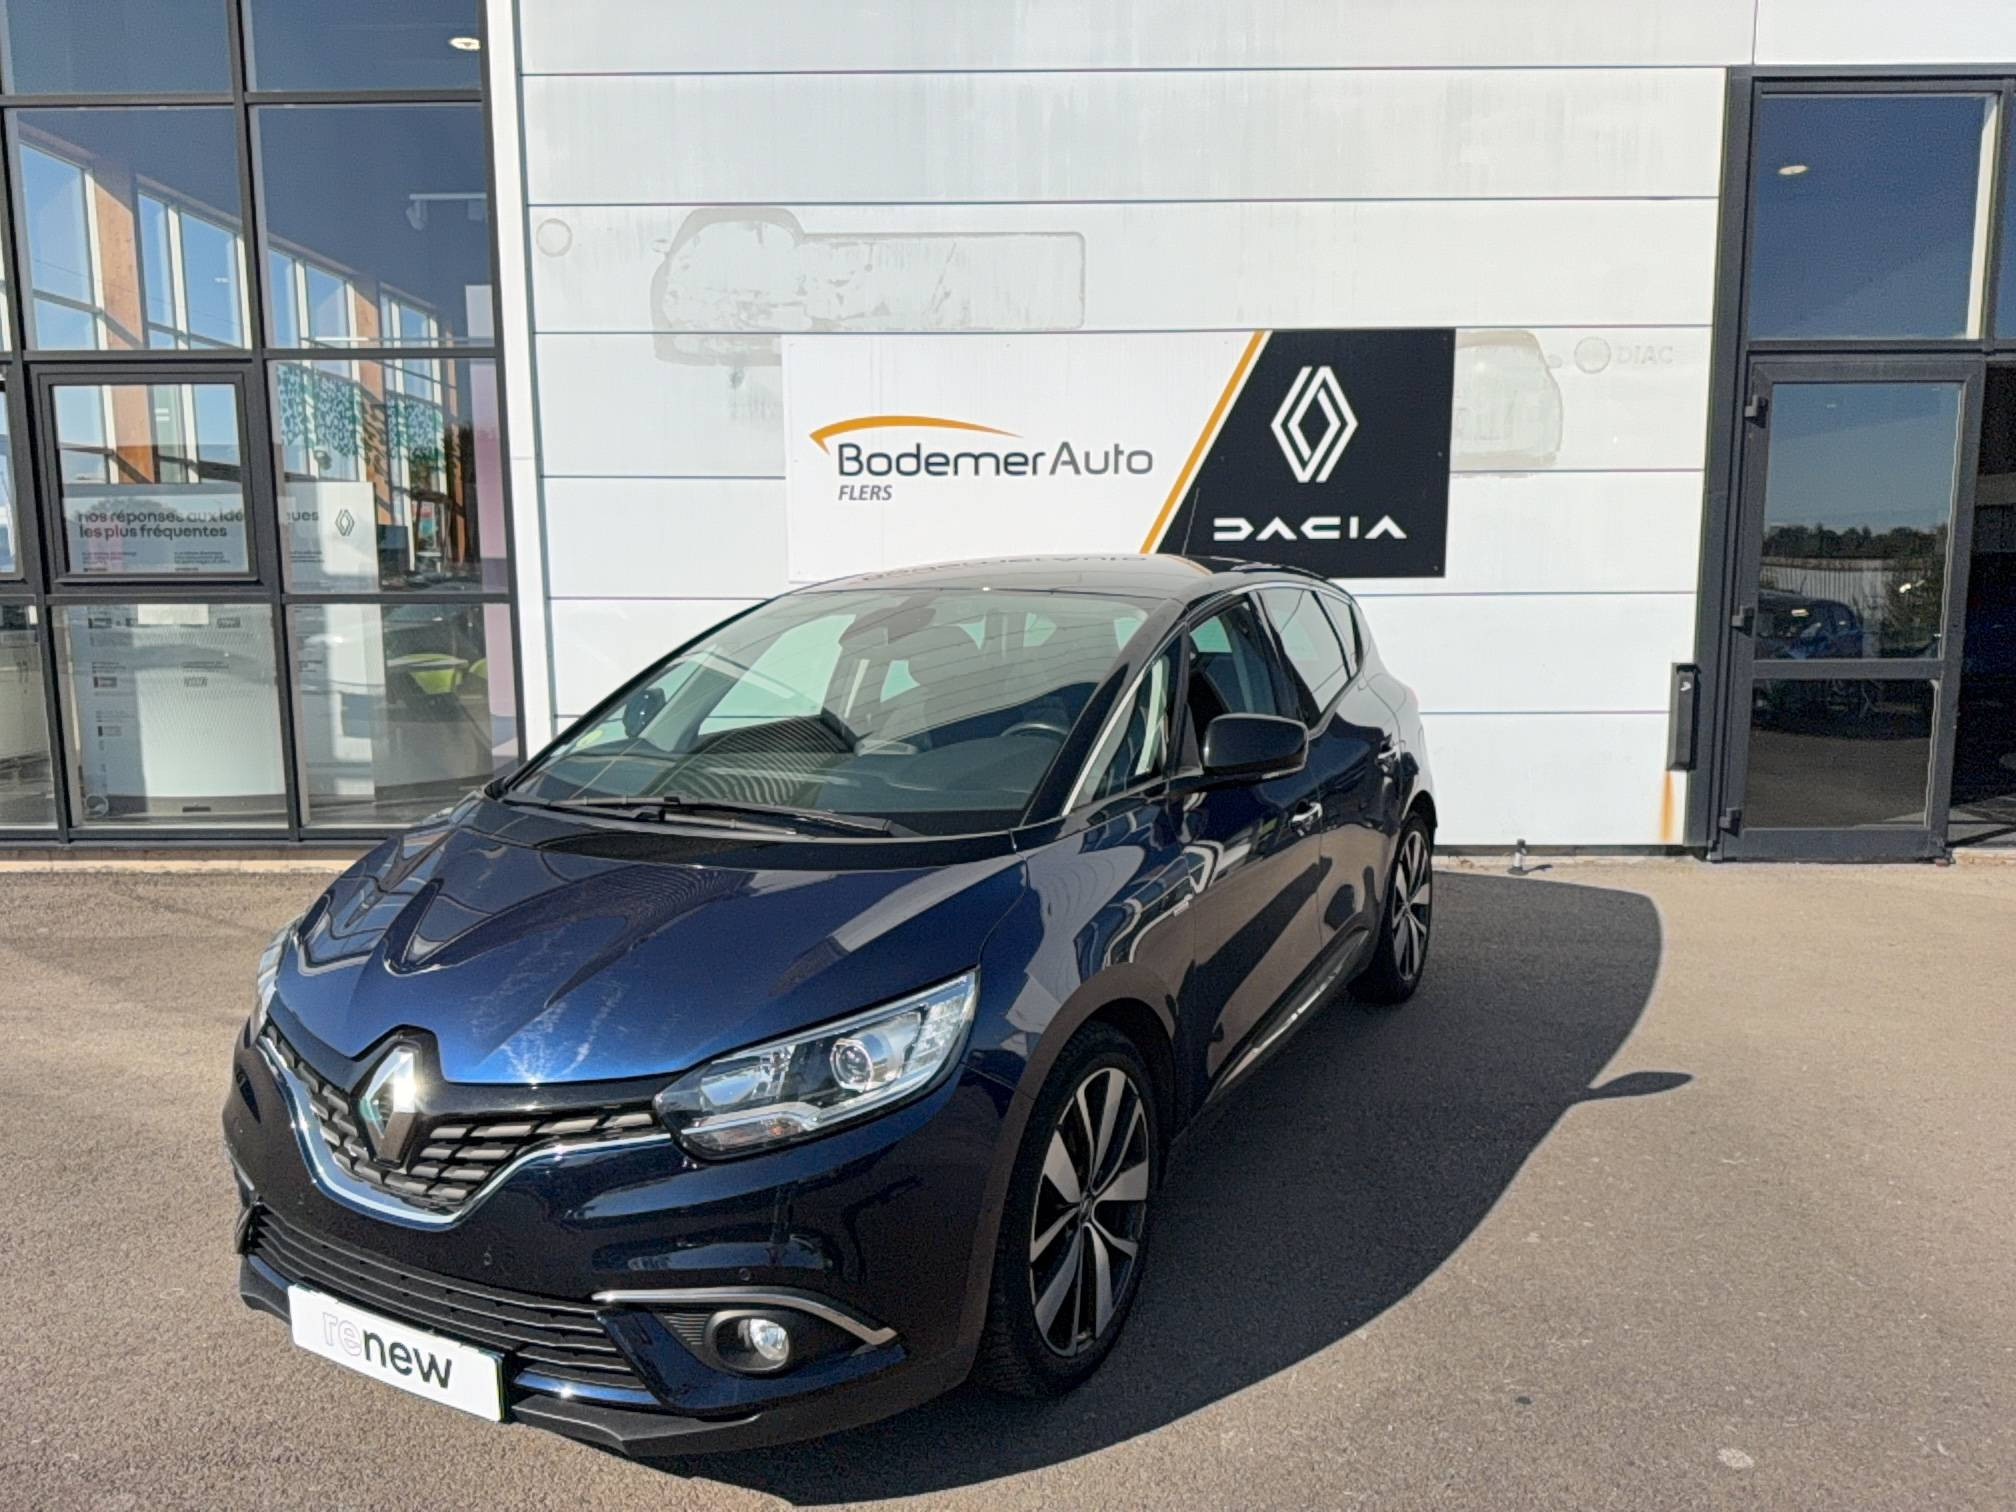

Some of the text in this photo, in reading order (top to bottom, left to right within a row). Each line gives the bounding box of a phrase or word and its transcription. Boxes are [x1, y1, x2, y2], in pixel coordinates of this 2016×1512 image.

[838, 484, 893, 501] FLERS
[110, 509, 184, 526] réponses
[79, 524, 227, 541] les plus fréquentes
[1213, 514, 1408, 541] DACIA
[322, 1310, 453, 1389] renew
